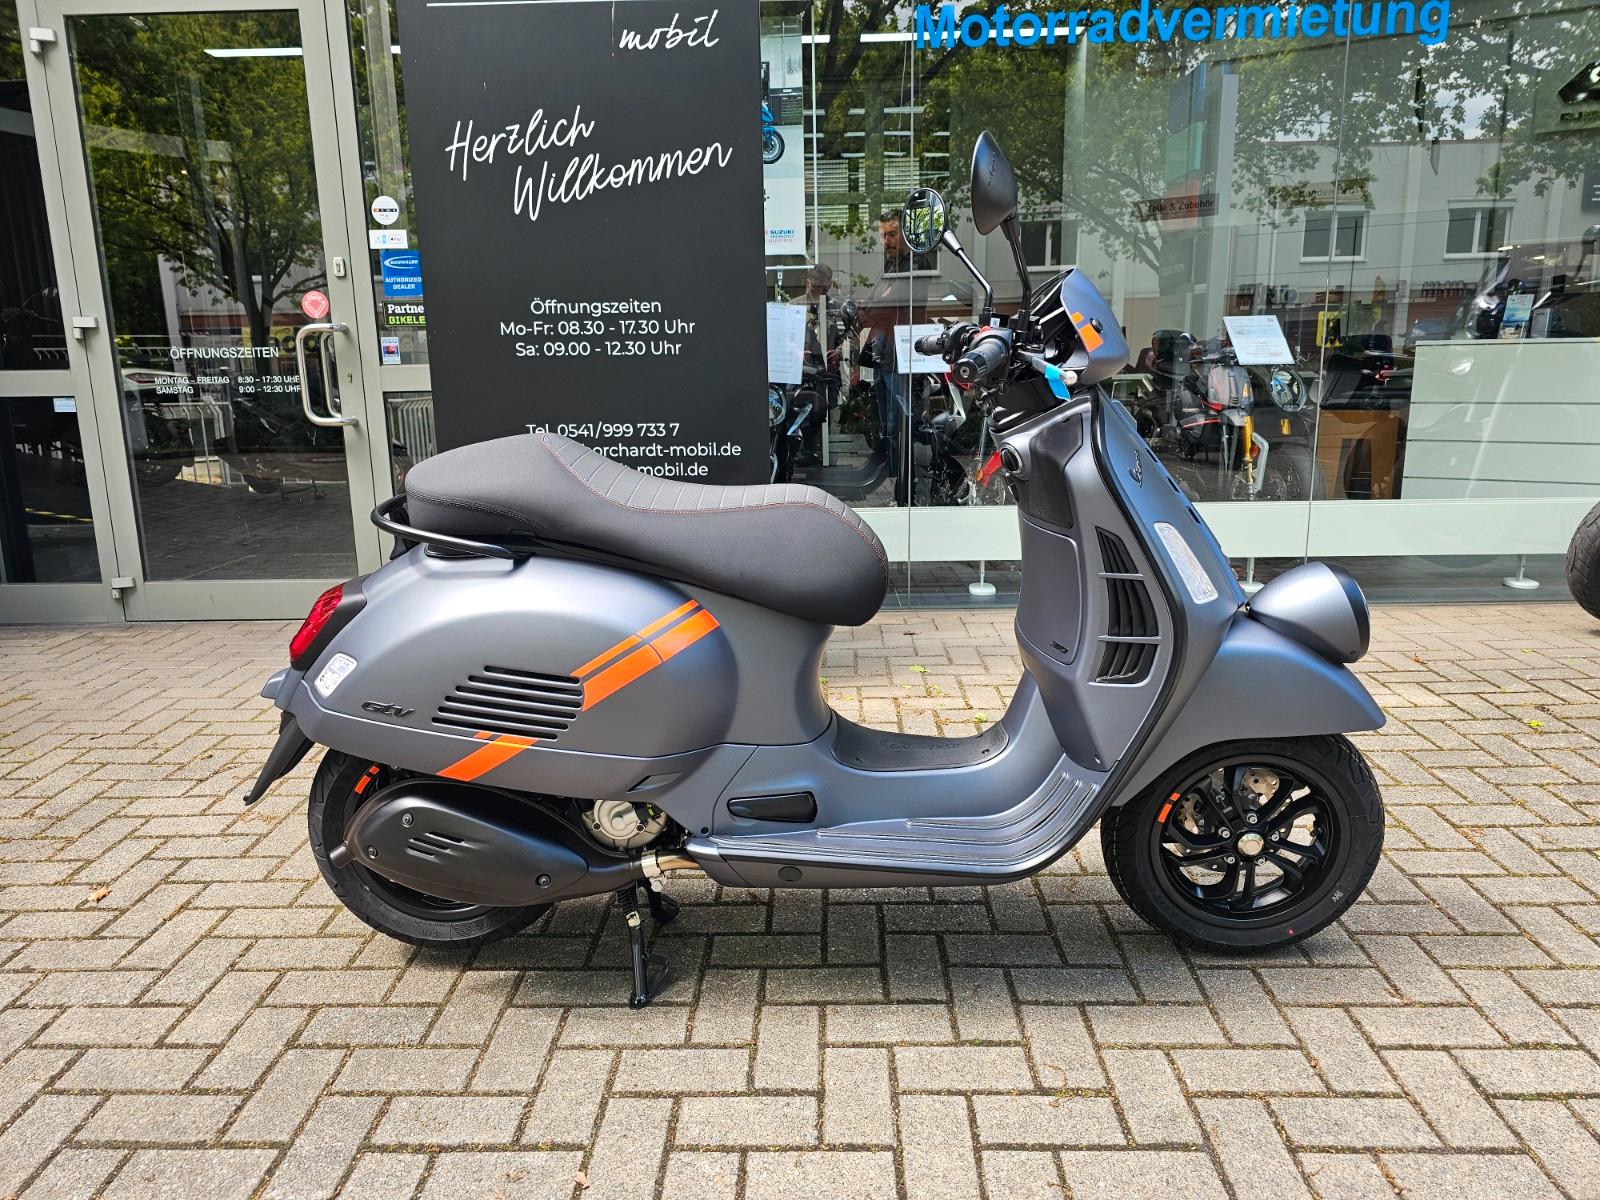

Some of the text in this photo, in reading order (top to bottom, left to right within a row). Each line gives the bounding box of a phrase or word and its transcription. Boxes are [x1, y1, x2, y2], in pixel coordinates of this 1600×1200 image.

[619, 9, 720, 50] mobil
[915, 0, 1450, 49] Motorradvermietung
[445, 105, 595, 181] Herzlich
[513, 142, 733, 222] Willkommen
[530, 297, 662, 317] Öffnungszeiten
[500, 321, 554, 336] Mo-Fr:
[557, 320, 605, 336] 08.30
[619, 319, 660, 335] 17.30
[664, 318, 696, 335] Uhr
[170, 346, 279, 359] ÖFFNUNGSZEITEN
[515, 342, 540, 357] Sa:
[543, 341, 591, 356] 09.00
[605, 340, 647, 356] 12.30
[650, 339, 682, 356] Uhr
[155, 377, 189, 385] MONTAG
[197, 376, 230, 384] FREITAG
[262, 375, 282, 383] 17:30
[156, 386, 194, 394] SAMSTAG
[264, 385, 283, 393] 12:30
[557, 421, 634, 439] 0541/999
[637, 423, 667, 437] 733
[670, 423, 680, 437] 7
[582, 442, 742, 458] orchardt-mobil.de
